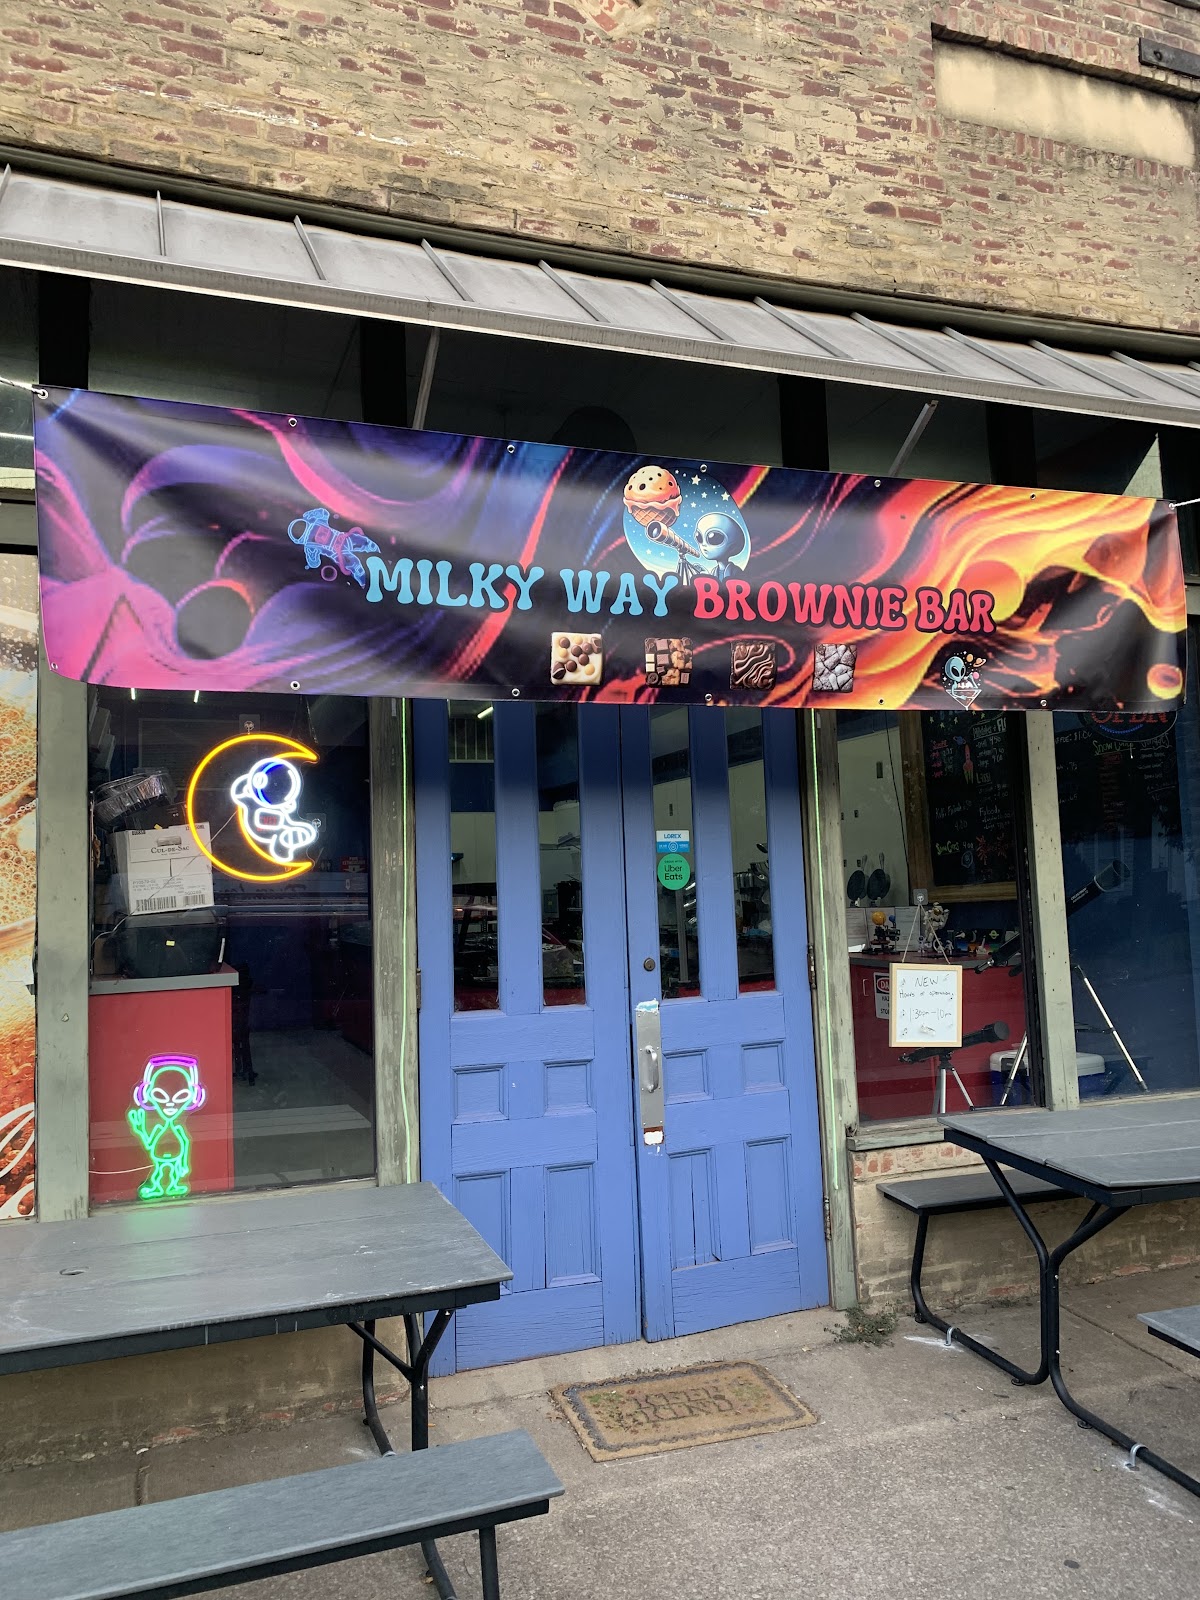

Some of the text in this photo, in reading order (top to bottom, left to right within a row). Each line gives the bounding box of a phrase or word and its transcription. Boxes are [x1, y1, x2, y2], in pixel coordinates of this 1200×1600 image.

[365, 556, 997, 633] MILKY WAY BROWNIE BAR
[664, 873, 683, 881] Eats
[915, 976, 939, 988] NEW
[899, 988, 915, 999] Hours
